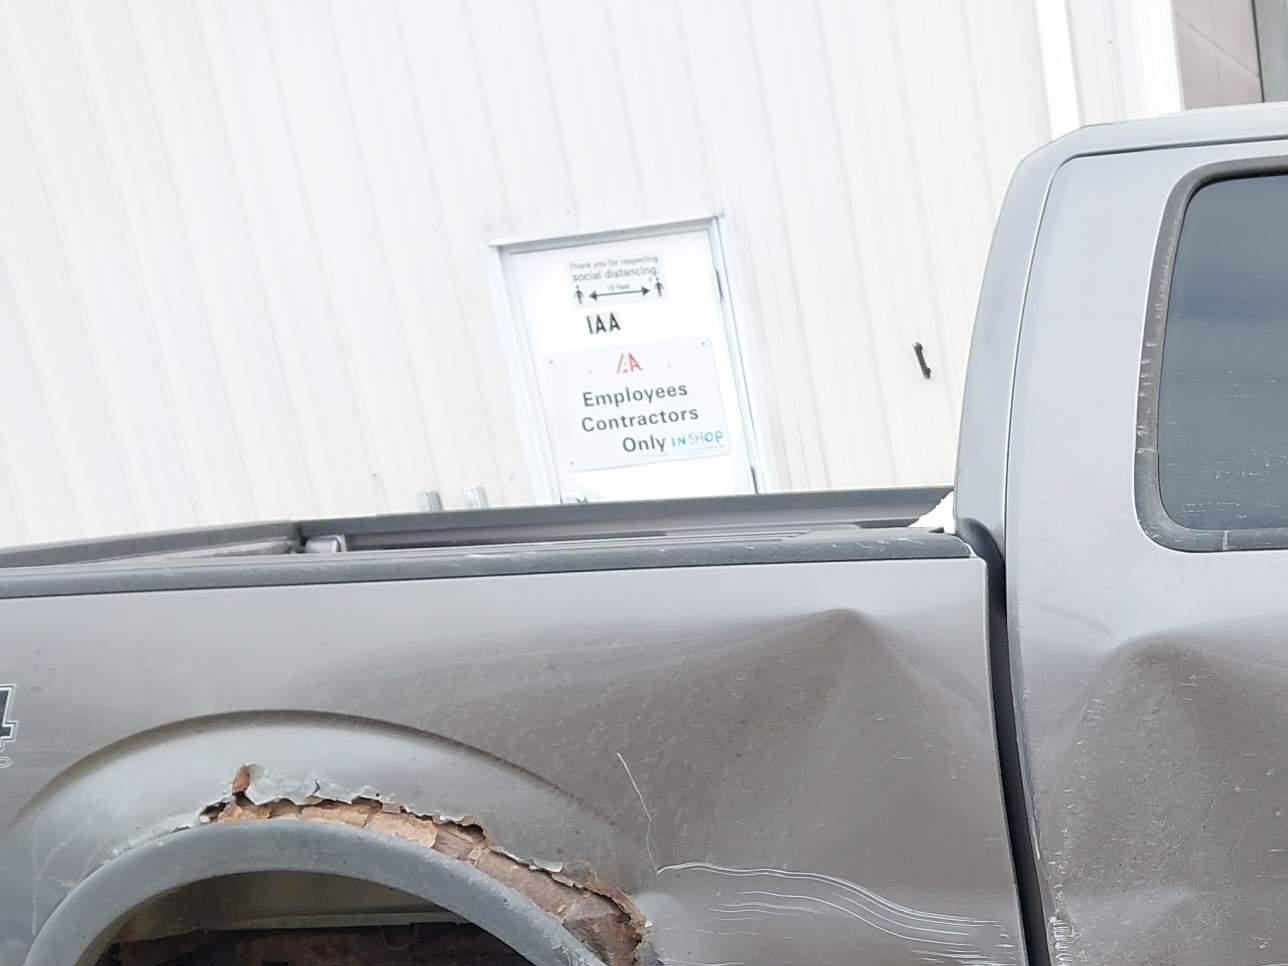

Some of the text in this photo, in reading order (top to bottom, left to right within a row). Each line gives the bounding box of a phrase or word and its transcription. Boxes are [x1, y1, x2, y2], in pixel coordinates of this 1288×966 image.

[572, 269, 602, 282] social
[586, 312, 621, 335] IAA
[582, 384, 688, 408] Employees
[582, 408, 699, 433] Contractors
[622, 435, 666, 453] Only
